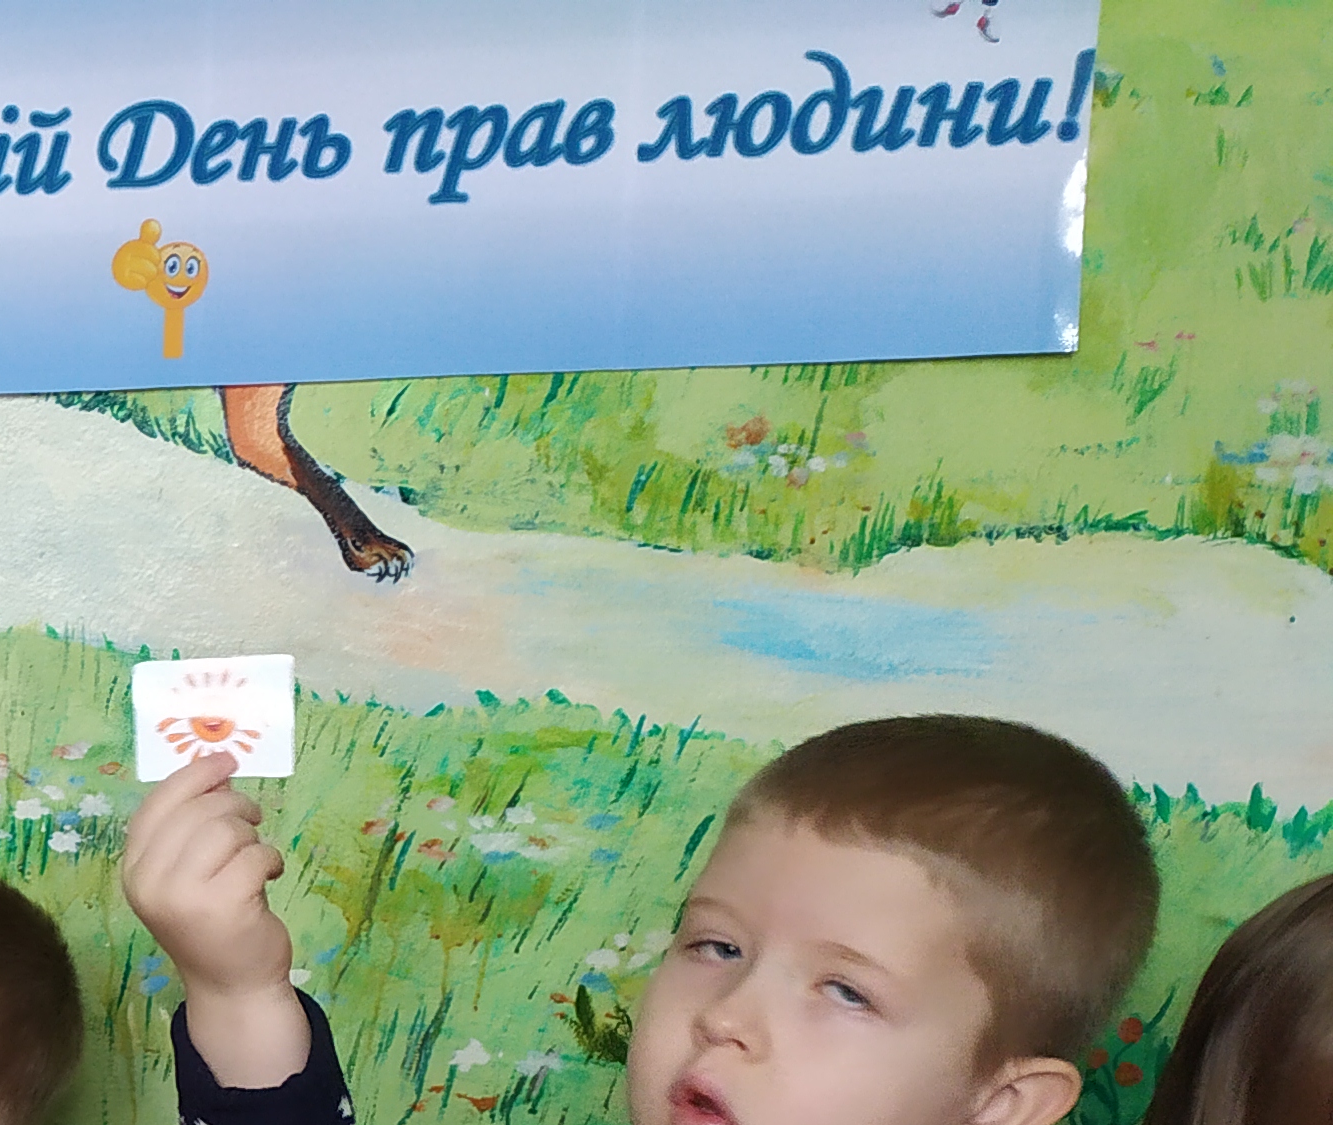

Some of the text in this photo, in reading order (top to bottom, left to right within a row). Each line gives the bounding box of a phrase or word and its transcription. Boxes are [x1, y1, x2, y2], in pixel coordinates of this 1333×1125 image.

[97, 98, 353, 190] День
[382, 97, 616, 205] прав
[636, 48, 1097, 163] людини!
